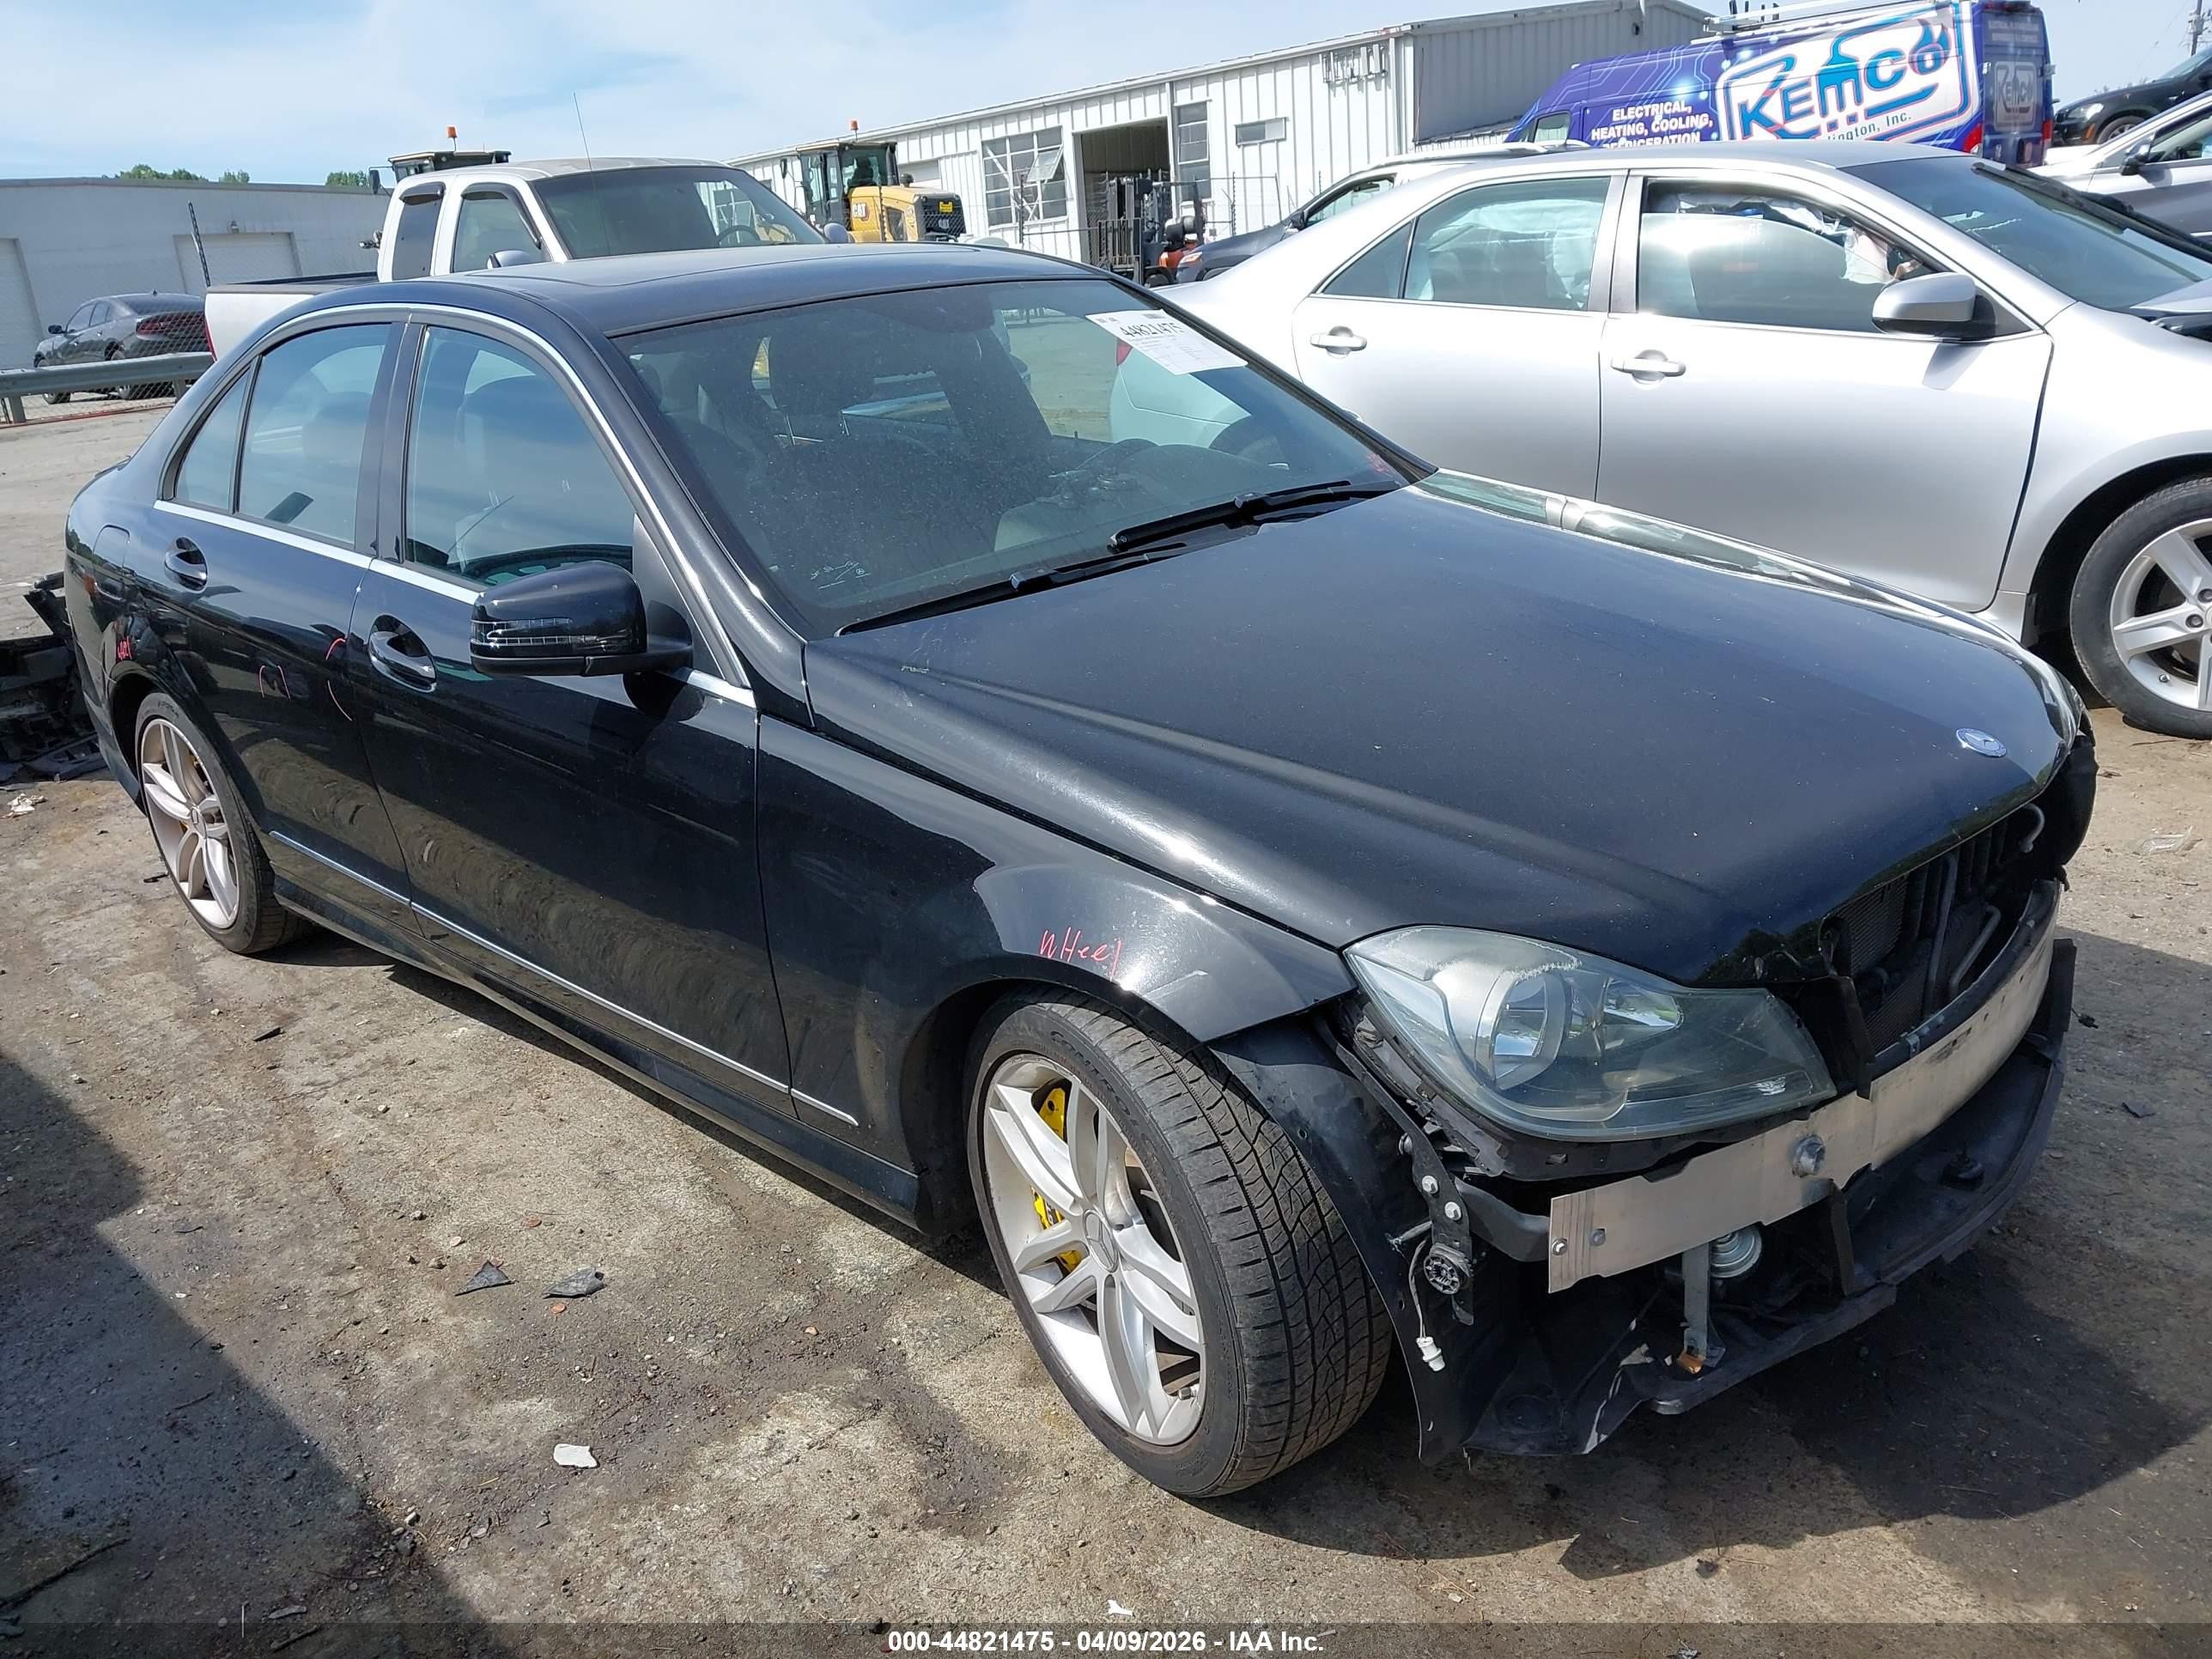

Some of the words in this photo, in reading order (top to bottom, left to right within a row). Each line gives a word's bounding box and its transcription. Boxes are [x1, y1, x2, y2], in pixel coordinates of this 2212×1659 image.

[1612, 100, 1692, 121] ELECTRICAL,
[1886, 112, 1912, 127] Inc.
[1591, 122, 1649, 141] HEATING,
[1650, 112, 1714, 133] COOLING,
[852, 202, 866, 218] CAT
